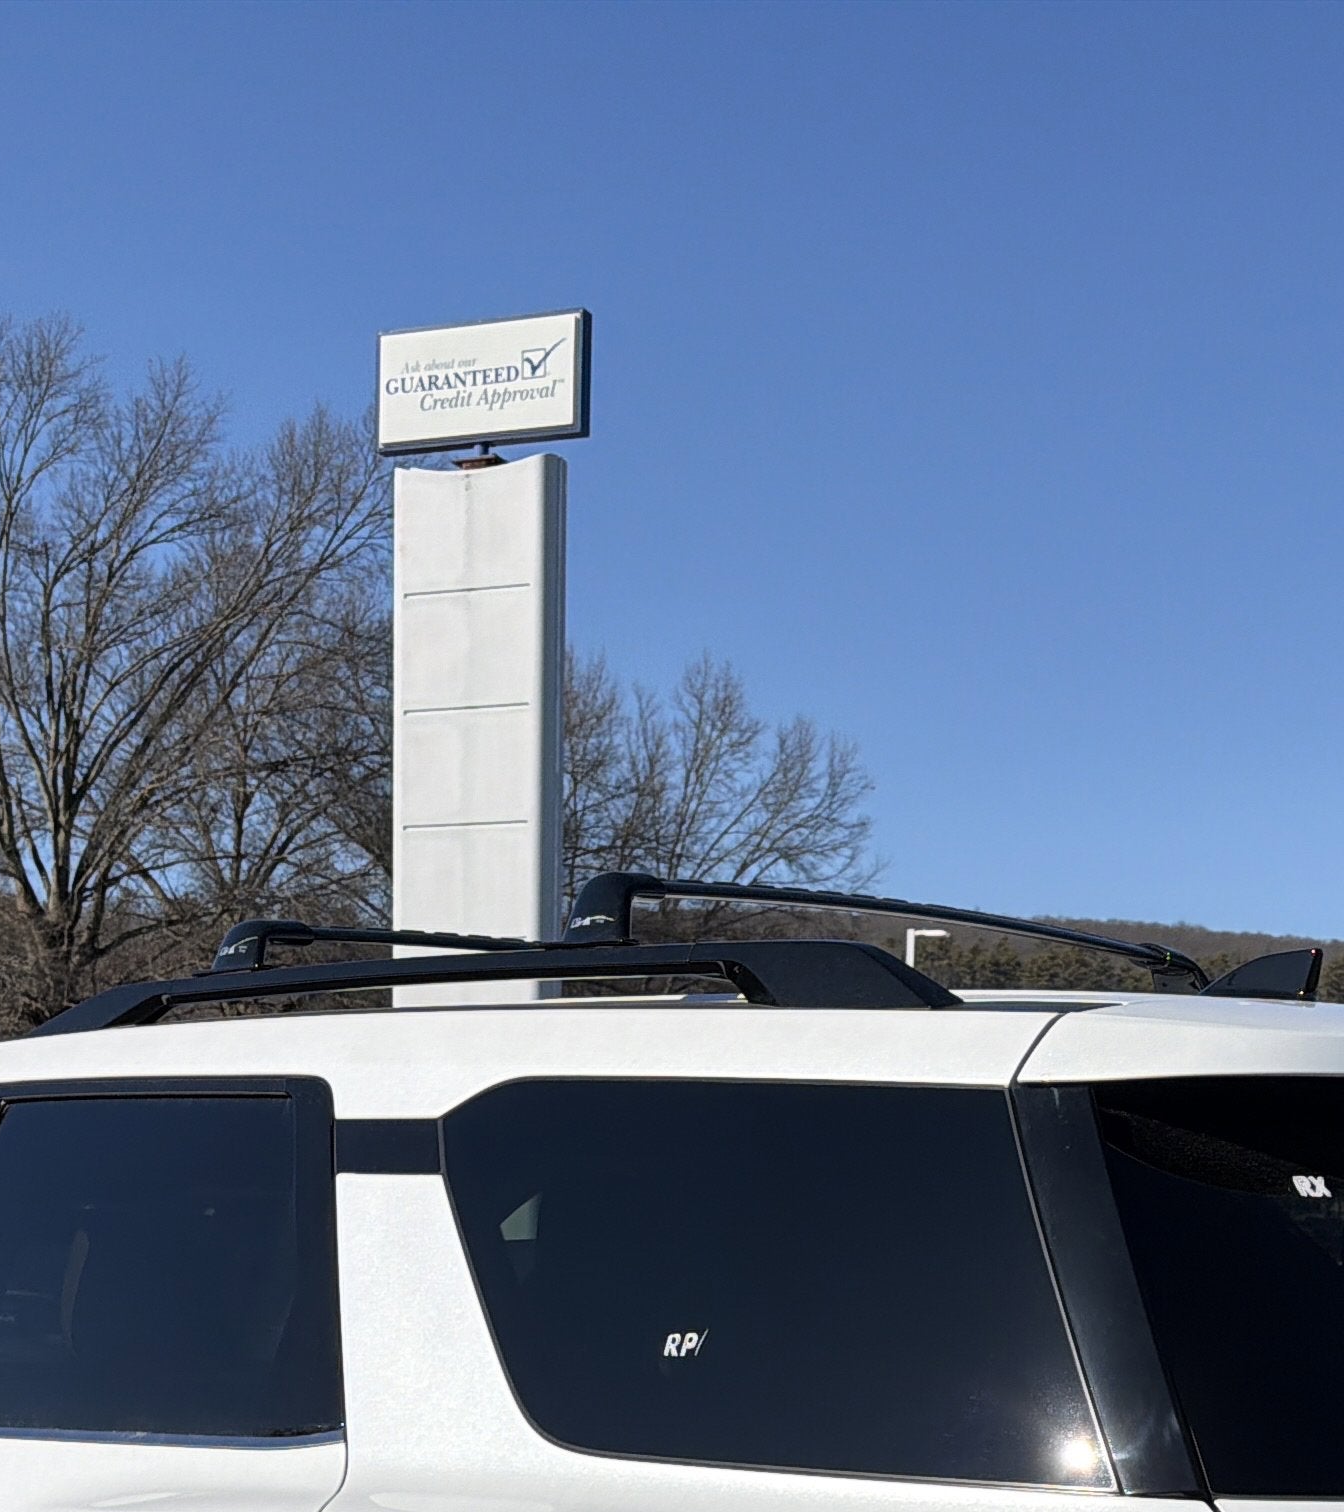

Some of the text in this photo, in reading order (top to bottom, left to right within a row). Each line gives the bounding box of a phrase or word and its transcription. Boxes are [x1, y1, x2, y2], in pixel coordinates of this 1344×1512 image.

[401, 357, 477, 374] Ask about our
[386, 366, 519, 395] GUARANTEED
[419, 390, 473, 411] Credit
